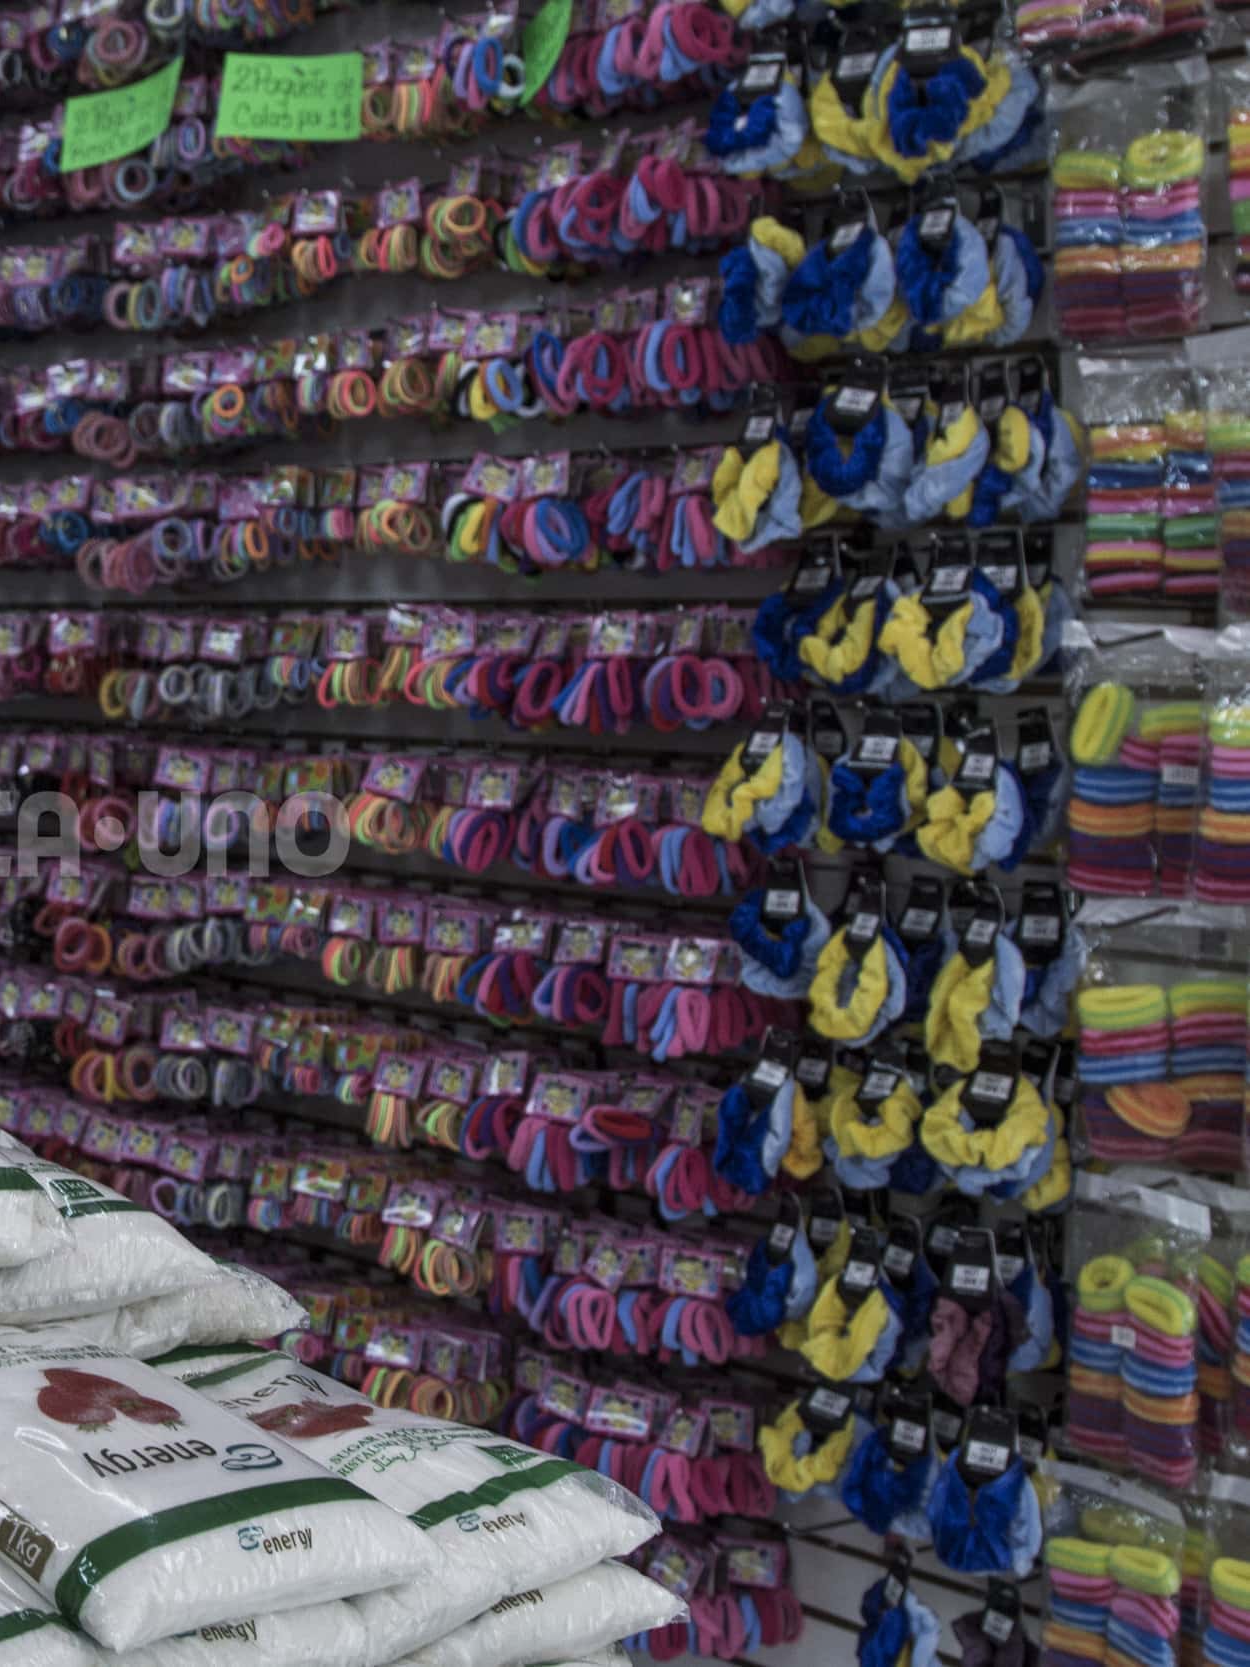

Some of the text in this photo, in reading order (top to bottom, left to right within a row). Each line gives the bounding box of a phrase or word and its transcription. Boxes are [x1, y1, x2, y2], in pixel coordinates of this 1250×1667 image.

[82, 1438, 218, 1478] energy
[5, 1521, 42, 1566] 1kg
[262, 1527, 314, 1555] energy
[491, 1586, 545, 1615] energy
[200, 1619, 258, 1643] energy
